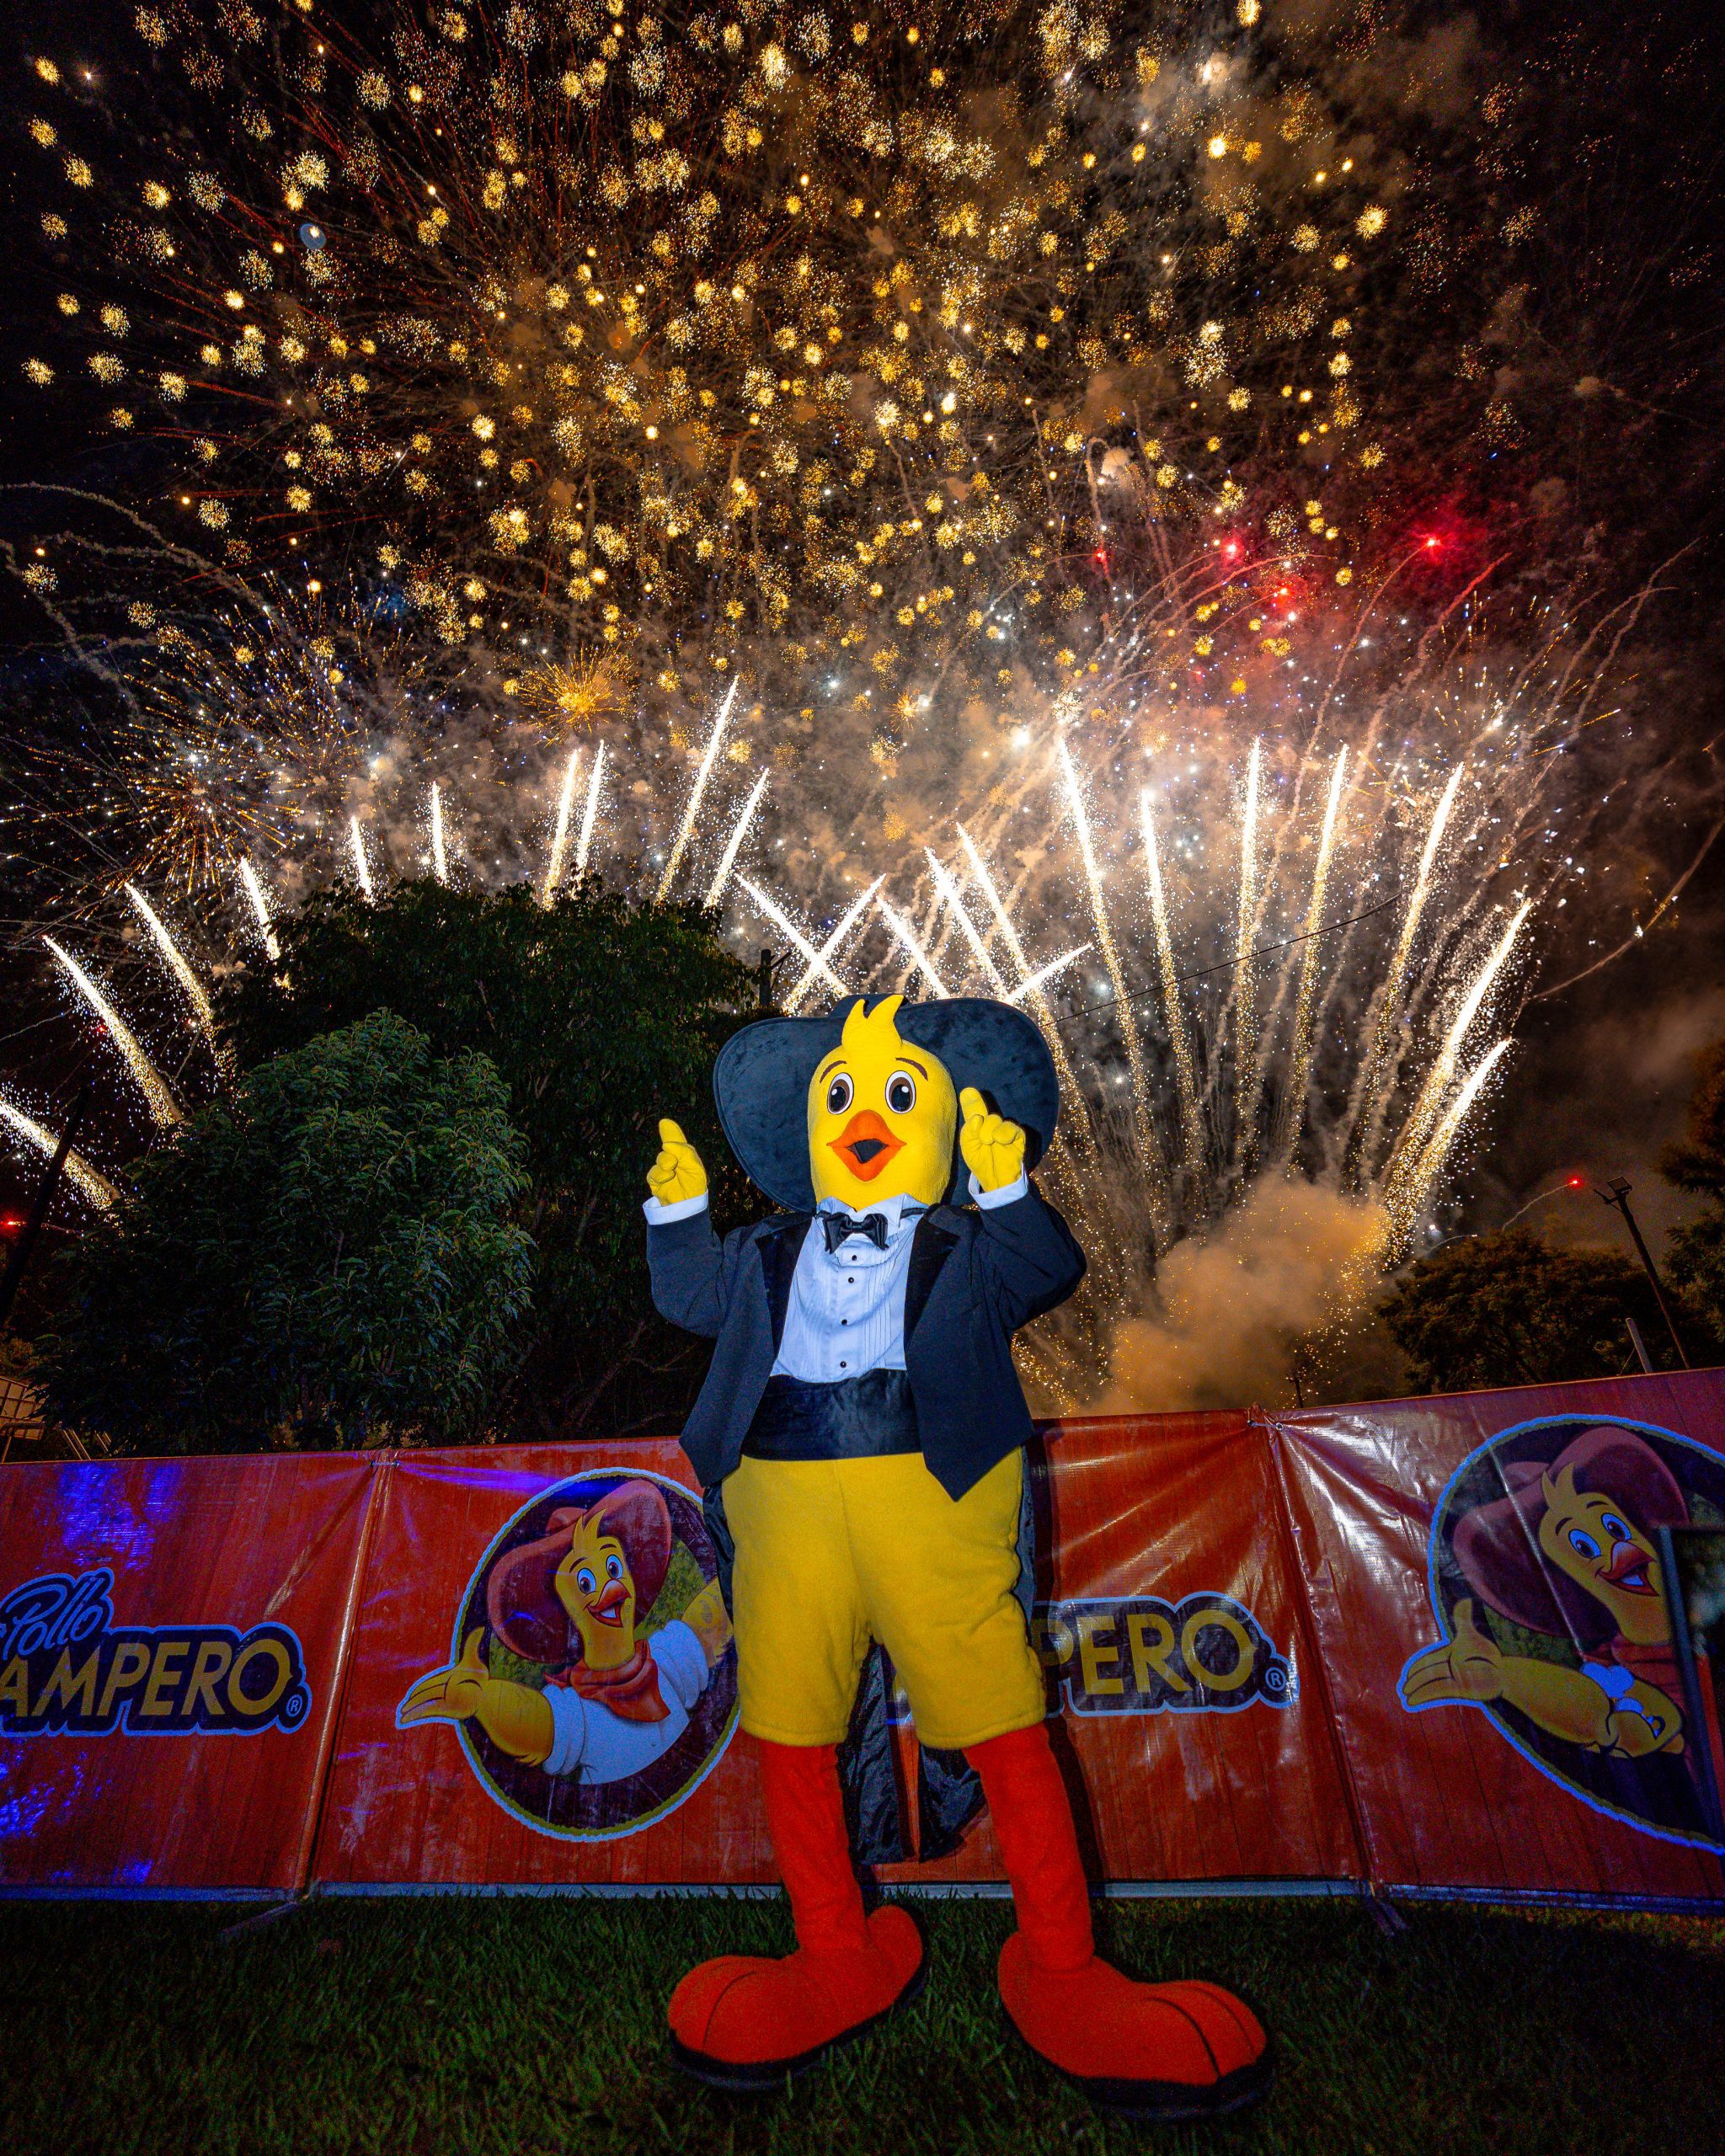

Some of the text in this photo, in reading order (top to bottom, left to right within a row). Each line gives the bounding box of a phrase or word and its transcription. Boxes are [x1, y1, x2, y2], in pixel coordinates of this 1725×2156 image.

[2, 1577, 104, 1661] Pollo
[1029, 1609, 1259, 1696] PERO
[0, 1638, 292, 1717] AMPERO
